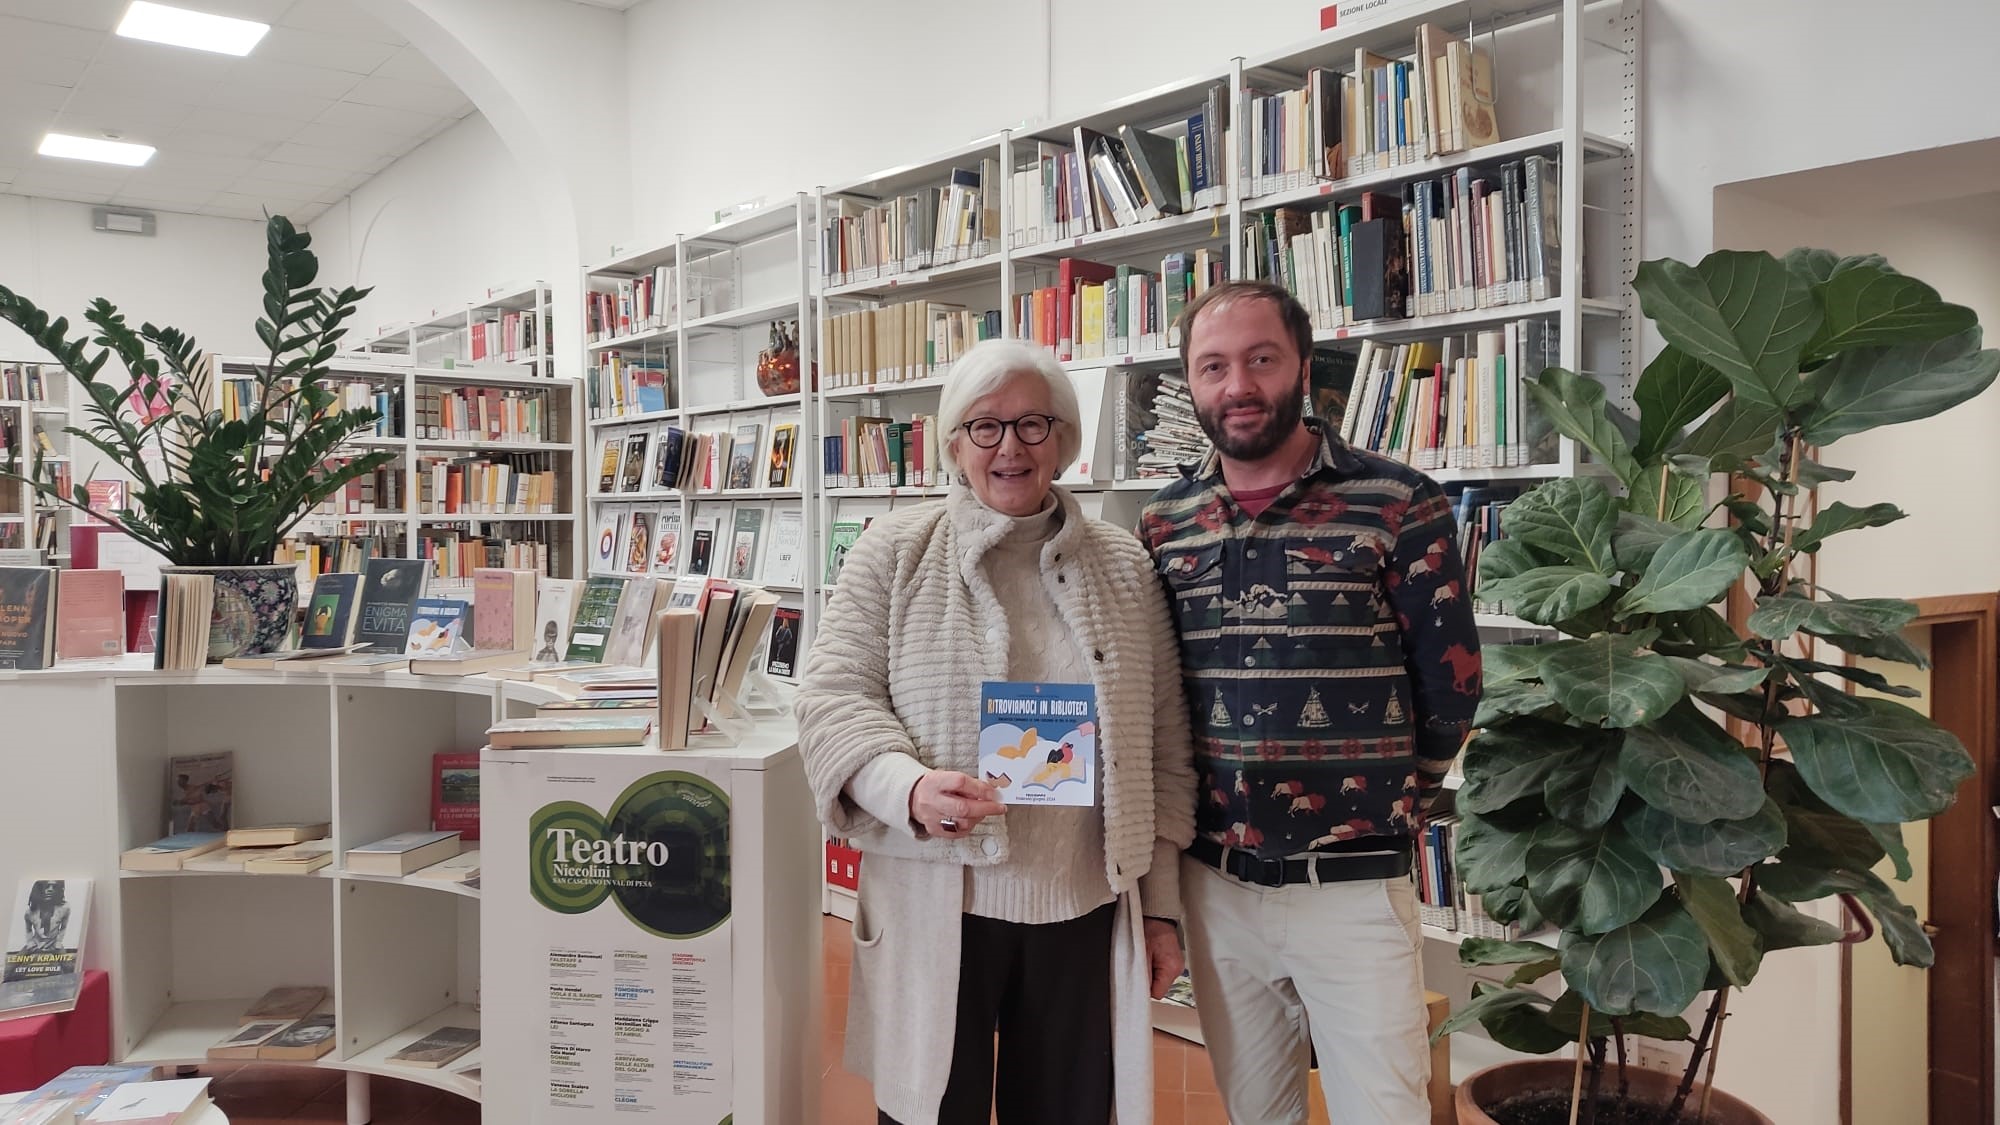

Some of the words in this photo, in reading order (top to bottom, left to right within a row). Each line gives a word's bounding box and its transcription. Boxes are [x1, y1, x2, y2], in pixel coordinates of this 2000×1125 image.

[1340, 5, 1364, 17] SEZIONE
[1118, 390, 1127, 452] DONATELLO
[0, 604, 29, 612] LENN
[365, 606, 408, 617] ENIGMA
[362, 617, 406, 632] EVITA
[987, 698, 1037, 715] RITROVIAMOCI
[1040, 699, 1048, 715] IN
[1050, 700, 1088, 716] BIBLIOTECA
[547, 828, 669, 867] Teatro
[553, 863, 611, 878] Niccolini
[612, 879, 626, 887] VAL
[635, 880, 653, 888] PESA
[7, 954, 36, 963] LENNY
[37, 953, 73, 962] KRAVITZ
